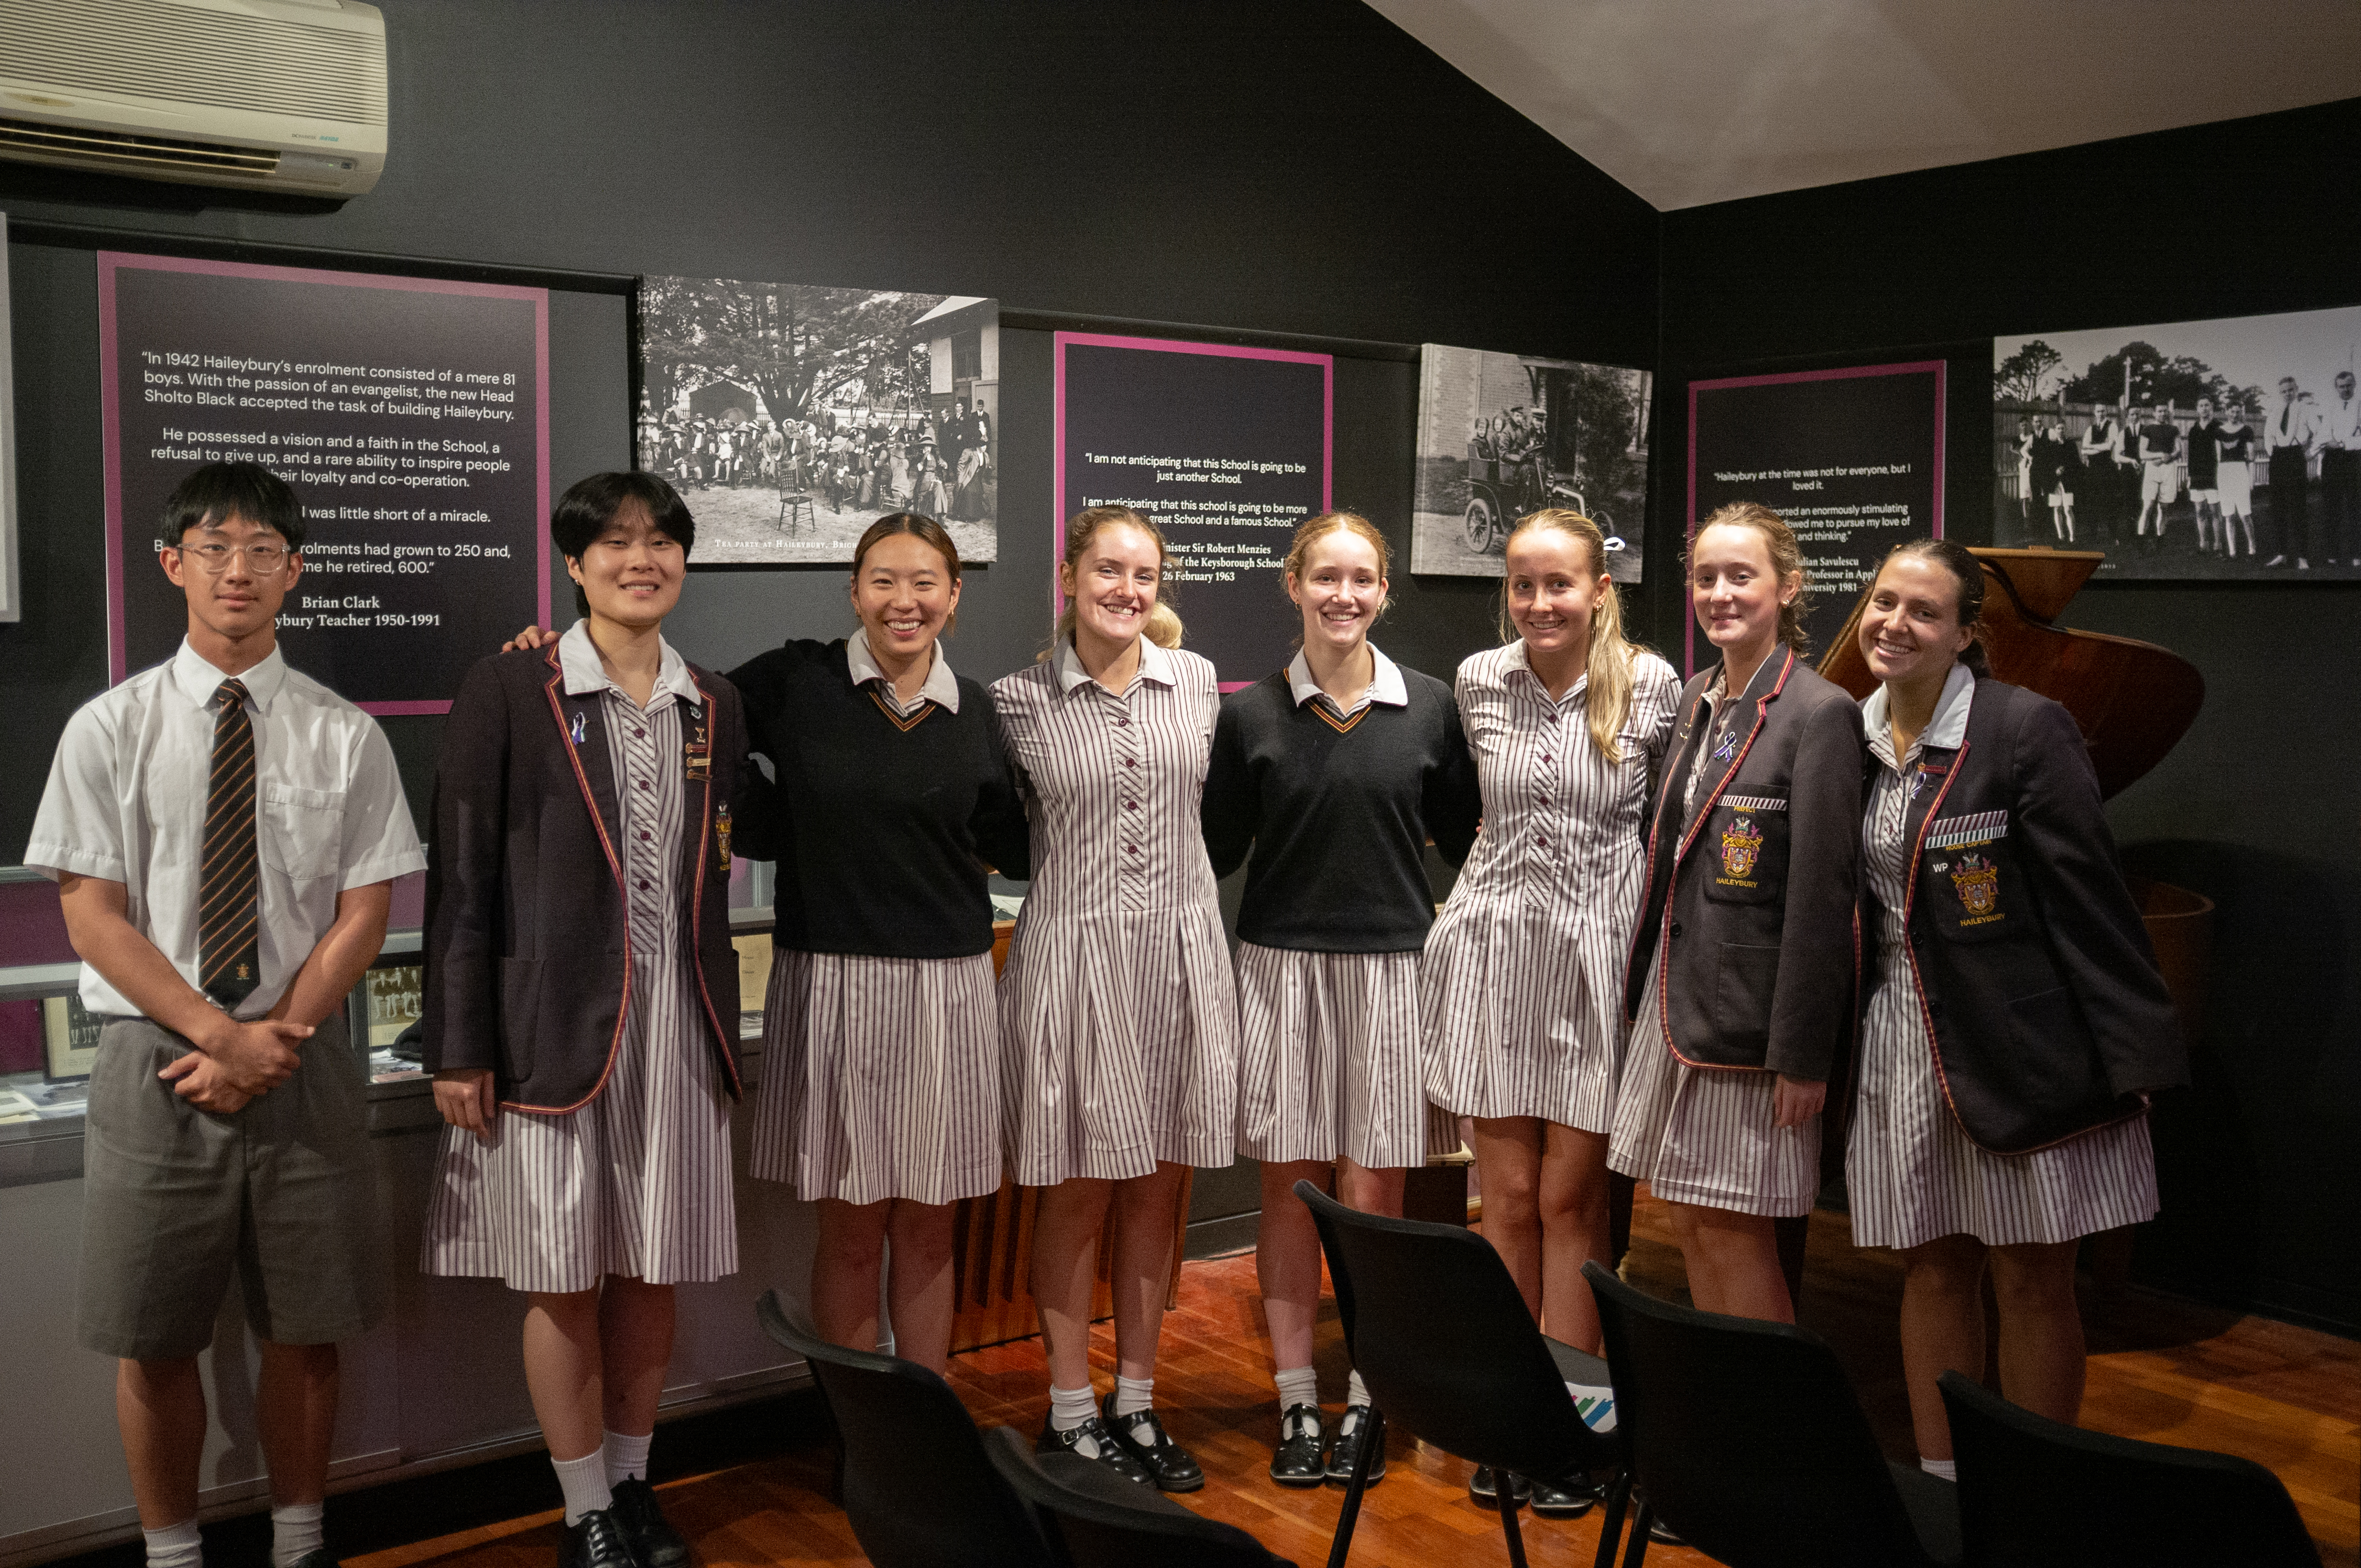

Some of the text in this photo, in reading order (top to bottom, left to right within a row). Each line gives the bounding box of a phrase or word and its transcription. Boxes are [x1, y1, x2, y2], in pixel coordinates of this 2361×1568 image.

[166, 352, 199, 367] 1942
[295, 362, 366, 377] enrolment
[369, 367, 434, 380] consisted
[439, 369, 451, 382] of
[455, 373, 463, 383] a
[467, 374, 499, 385] mere
[503, 373, 515, 385] 81
[145, 371, 514, 402] boys. With the passion of an evangelist, the new Head
[145, 389, 514, 423] Sholto Black accepted the task of building Haileybury.
[164, 428, 499, 455] He possessed a vision and a faith in the School, a
[151, 446, 510, 473] refusal to give up, and a rare ability to inspire people
[1094, 455, 1109, 464] am
[1111, 455, 1127, 465] not
[1129, 455, 1181, 470] anticipating
[1183, 458, 1201, 468] that
[1203, 458, 1219, 469] this
[1221, 459, 1249, 470] School
[1252, 461, 1259, 471] is
[1260, 461, 1282, 474] going
[1285, 464, 1293, 472] to
[1295, 463, 1305, 473] be
[271, 469, 469, 488] eir loyalty and co-operation.
[1156, 470, 1242, 483] just another School.
[1759, 471, 1766, 480] at
[1769, 470, 1781, 479] the
[1783, 470, 1801, 478] time
[1803, 469, 1819, 477] was
[1820, 468, 1834, 477] not
[1836, 466, 1847, 476] for
[1849, 466, 1889, 476] everyone,
[1891, 464, 1906, 473] but
[1908, 464, 1910, 472] I
[1793, 481, 1814, 491] loved
[1083, 497, 1086, 507] I
[1088, 498, 1103, 507] am
[1161, 499, 1178, 510] that
[1180, 500, 1197, 510] this
[1199, 500, 1227, 511] school
[1230, 502, 1236, 511] is
[1238, 502, 1261, 515] going
[1263, 504, 1271, 513] to
[1274, 503, 1284, 513] be
[1286, 505, 1307, 514] more
[1812, 505, 1860, 516] enormously
[1862, 503, 1908, 515] stimulating
[309, 509, 336, 519] was
[340, 507, 369, 519] little
[374, 508, 408, 520] short
[412, 508, 425, 520] of
[429, 512, 437, 521] a
[440, 509, 490, 522] miracle.
[1174, 514, 1204, 525] School
[1205, 515, 1222, 525] and
[1231, 515, 1262, 526] famous
[1826, 519, 1835, 527] to
[1836, 519, 1865, 529] pursue
[1867, 519, 1880, 529] my
[1882, 517, 1900, 526] love
[1901, 516, 1910, 526] of
[1797, 531, 1813, 541] and
[301, 542, 510, 559] rolments had grown to 250 and,
[1162, 542, 1271, 554] inister Sir Robert Menzies
[327, 560, 343, 573] he
[347, 561, 394, 574] retired,
[1185, 557, 1199, 567] the
[1201, 557, 1254, 570] Keysborough
[1257, 558, 1283, 568] School
[1796, 556, 1858, 566] ulian Savulescu
[1163, 570, 1234, 583] 26 February 1963
[1846, 570, 1853, 579] in
[1856, 569, 1876, 581] Appl
[1839, 582, 1857, 592] 1981
[302, 595, 379, 608] Brian Clark
[275, 613, 439, 630] ybury Teacher 1950-1991
[1933, 863, 1948, 873] WP
[1716, 878, 1758, 888] HAILEYBURY
[1960, 913, 2005, 926] HAILEYBURY
